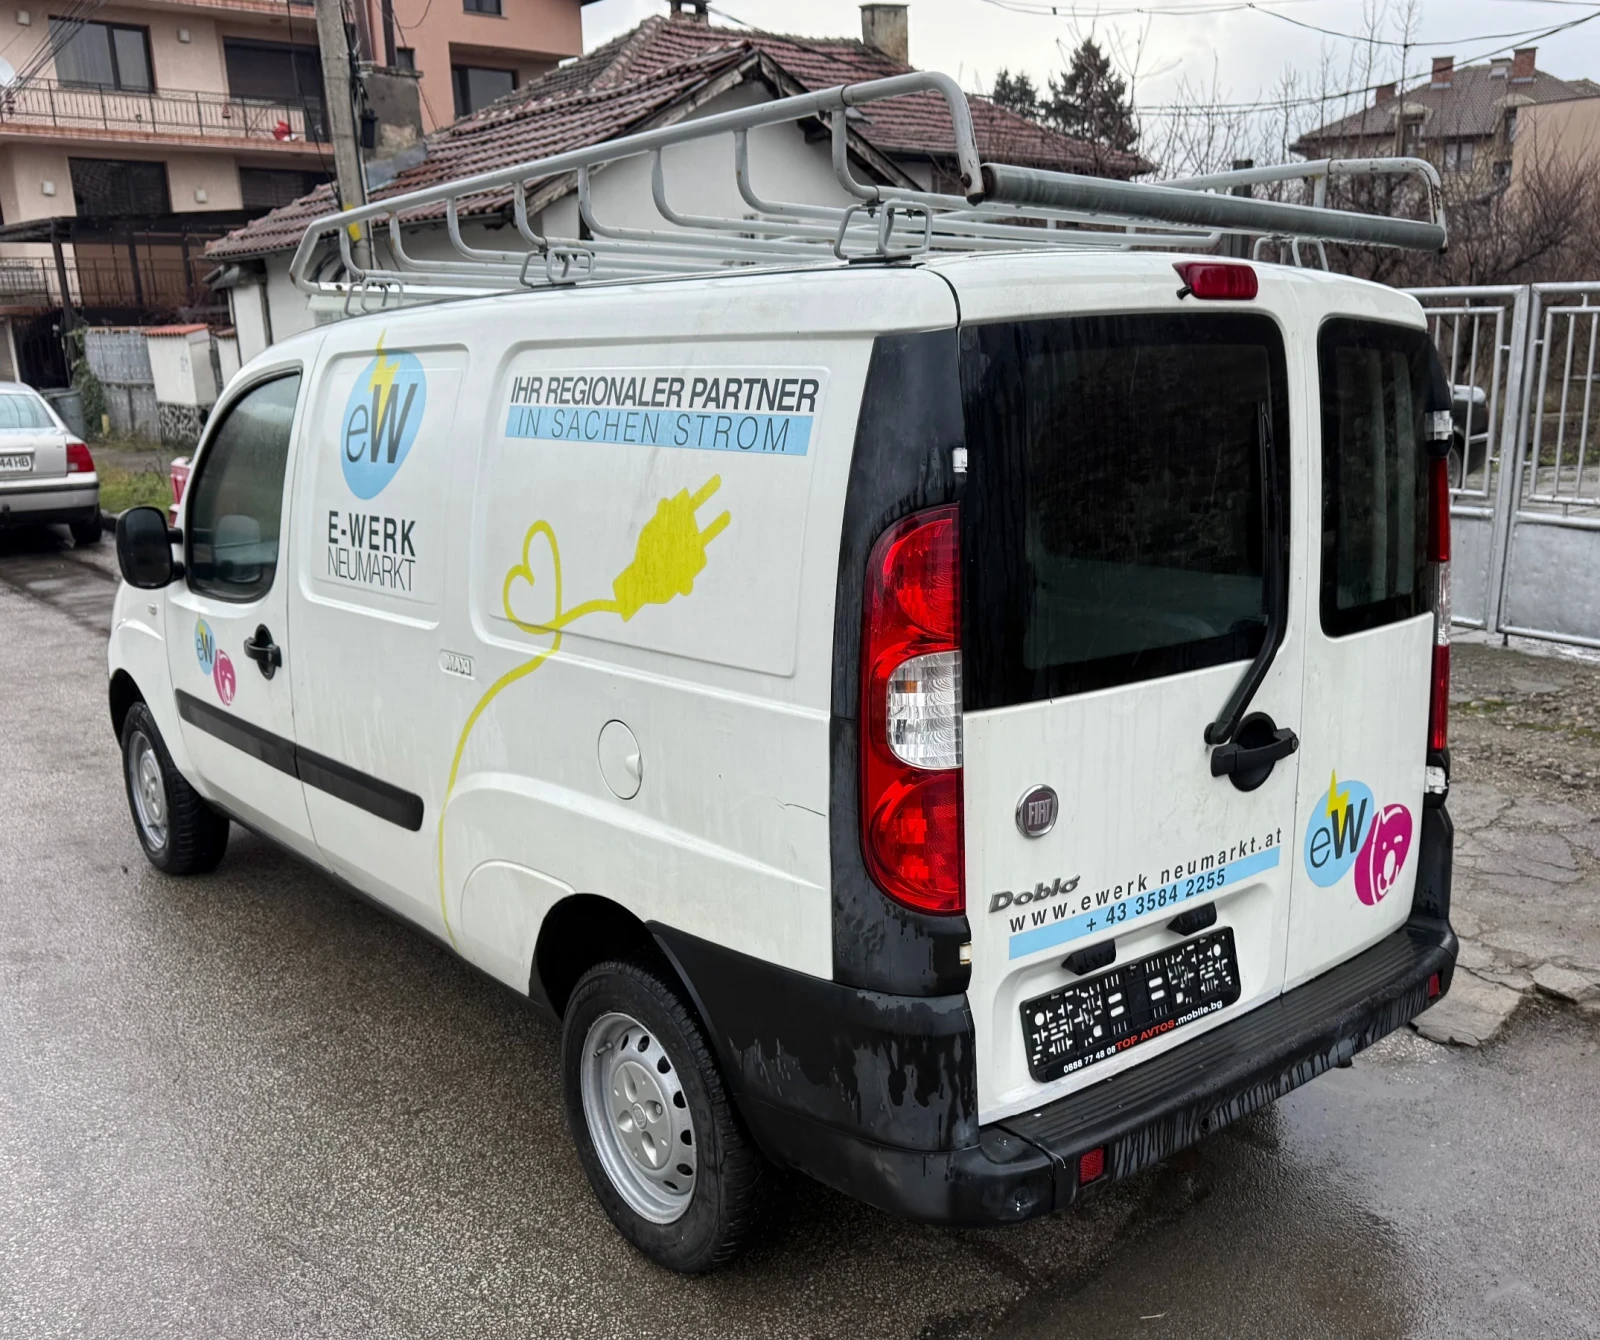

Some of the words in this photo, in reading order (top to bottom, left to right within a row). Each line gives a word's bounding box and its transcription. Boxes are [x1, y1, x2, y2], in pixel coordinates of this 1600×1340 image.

[511, 377, 542, 403] IHR
[545, 376, 685, 408] REGIONALER
[689, 378, 819, 412] PARTNER
[517, 408, 541, 436] IN
[551, 409, 660, 443] SACHEN
[674, 413, 791, 452] STROM
[328, 510, 416, 557] E-WERK
[327, 545, 416, 592] NEUMARKT
[1028, 798, 1052, 826] FIAT
[1086, 917, 1097, 932] +
[1105, 902, 1127, 925] 43
[1135, 884, 1178, 915] 3584
[1185, 868, 1226, 898] 2255
[1063, 1061, 1083, 1073] 0888
[1084, 1055, 1094, 1065] 77
[1096, 1050, 1105, 1060] 48
[1115, 1035, 1138, 1051] TOP
